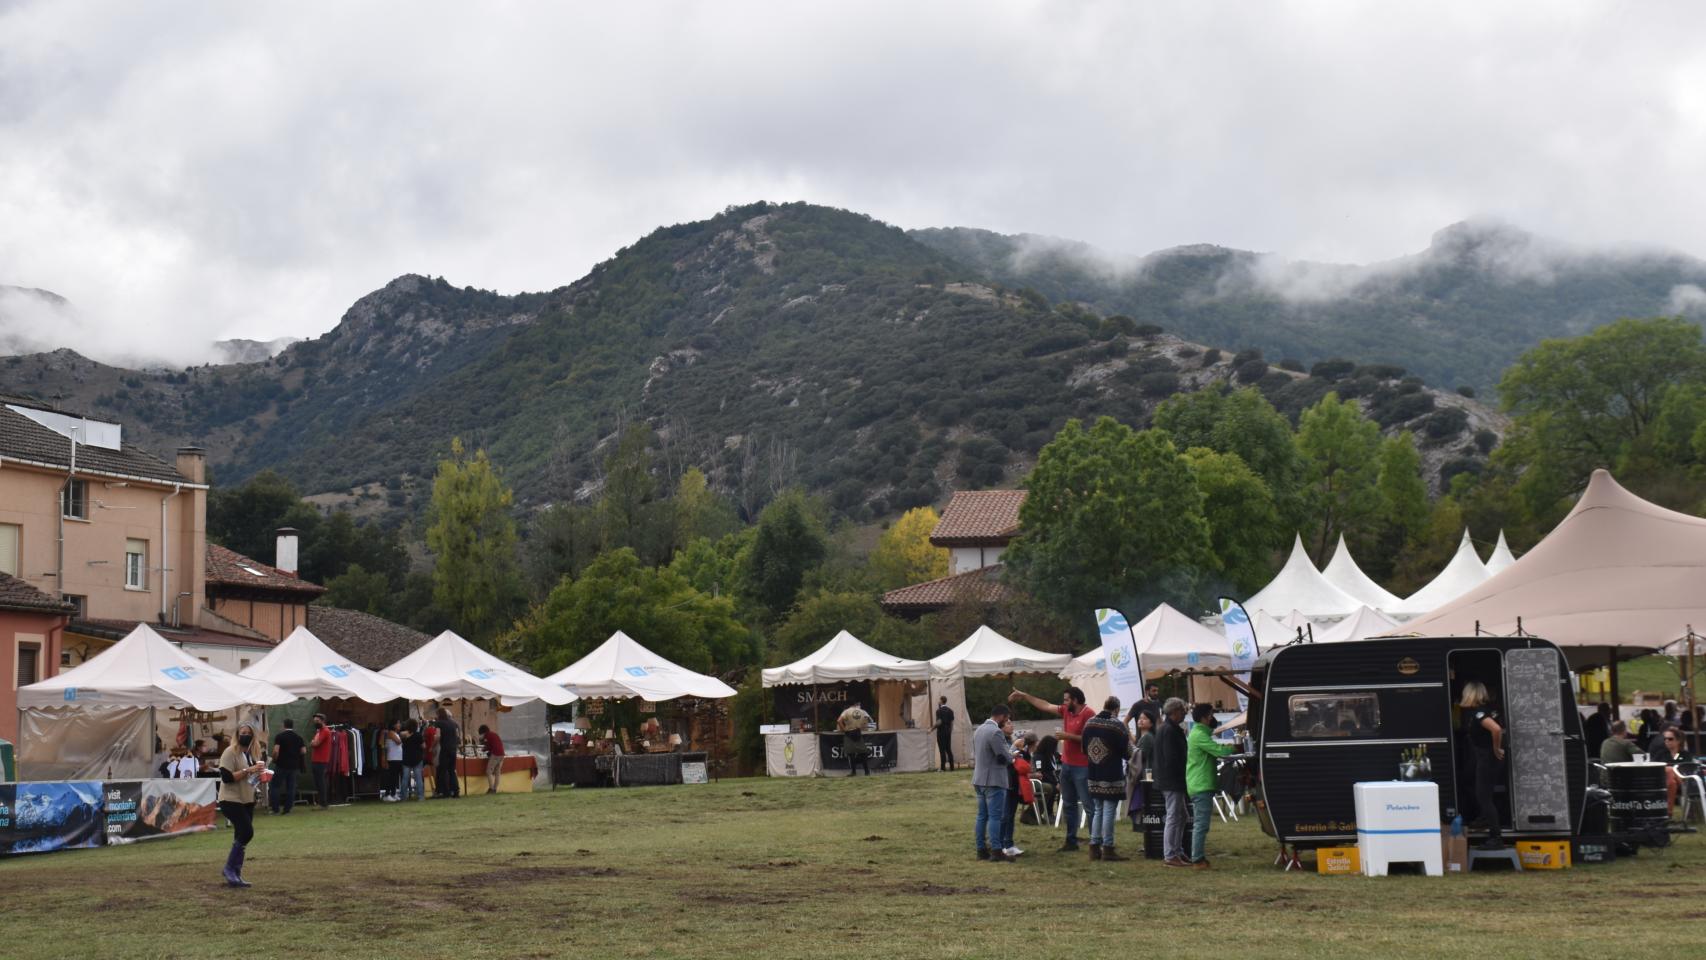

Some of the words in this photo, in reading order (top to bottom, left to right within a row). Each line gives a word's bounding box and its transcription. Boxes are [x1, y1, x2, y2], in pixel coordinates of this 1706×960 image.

[797, 690, 847, 703] SMACH
[831, 745, 884, 759] SCH
[107, 789, 121, 800] visit
[107, 824, 122, 833] .com
